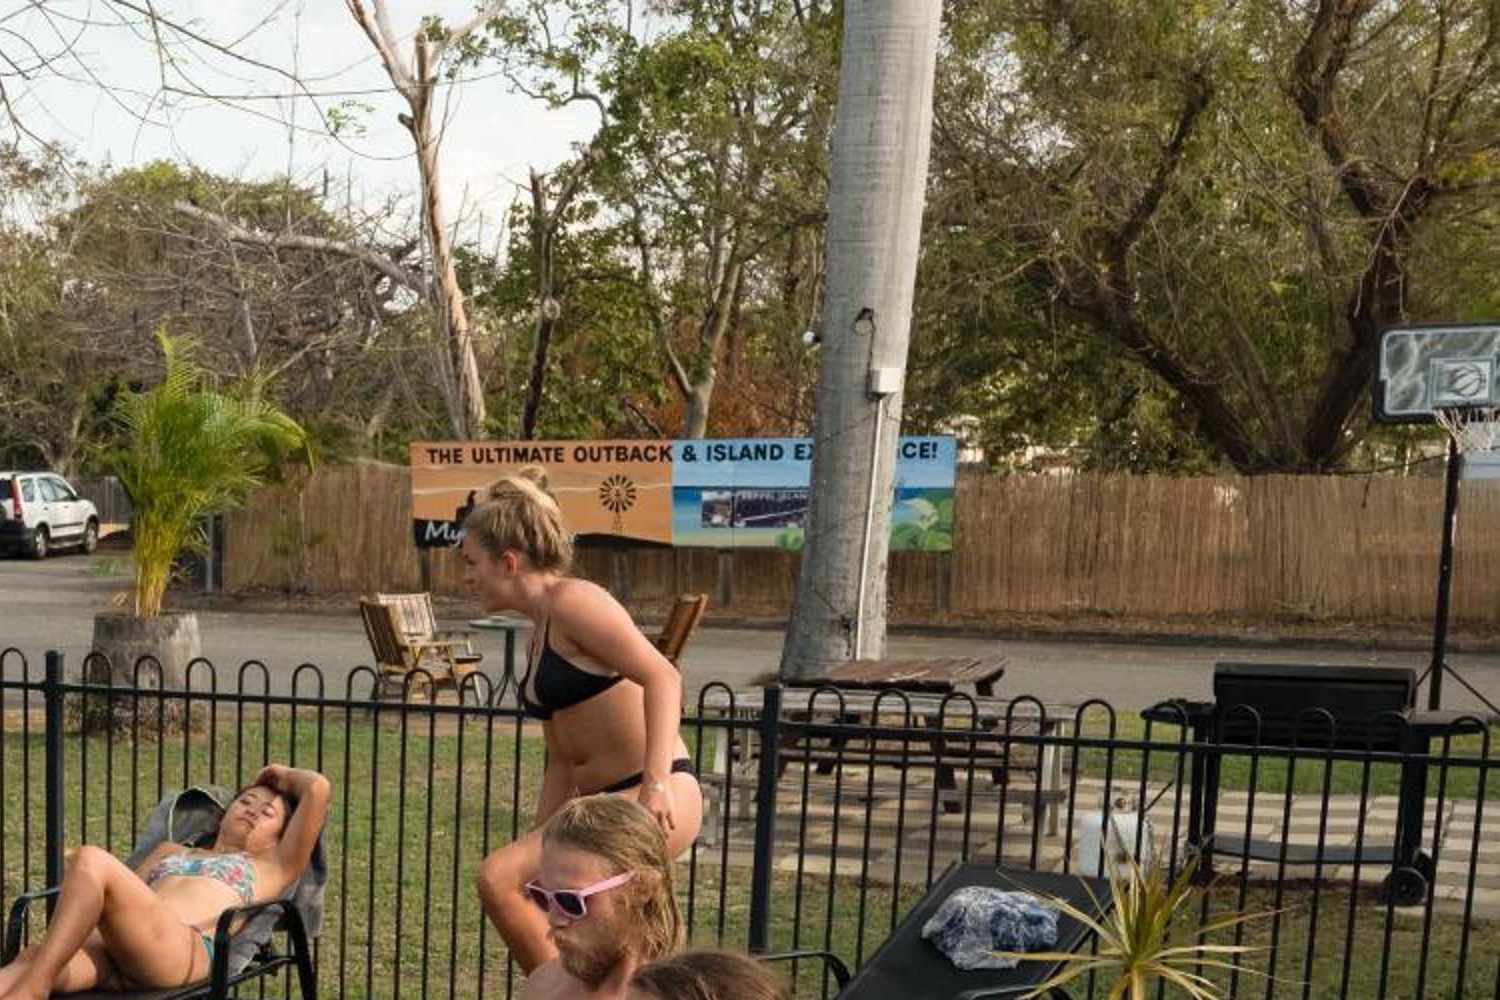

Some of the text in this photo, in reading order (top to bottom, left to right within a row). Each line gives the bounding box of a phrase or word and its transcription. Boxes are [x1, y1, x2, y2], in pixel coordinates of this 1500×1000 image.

[426, 448, 463, 464] THE
[472, 447, 565, 463] ULTIMATE
[573, 446, 673, 463] OUTBACK
[681, 444, 697, 462] &
[707, 444, 784, 462] ISLAND
